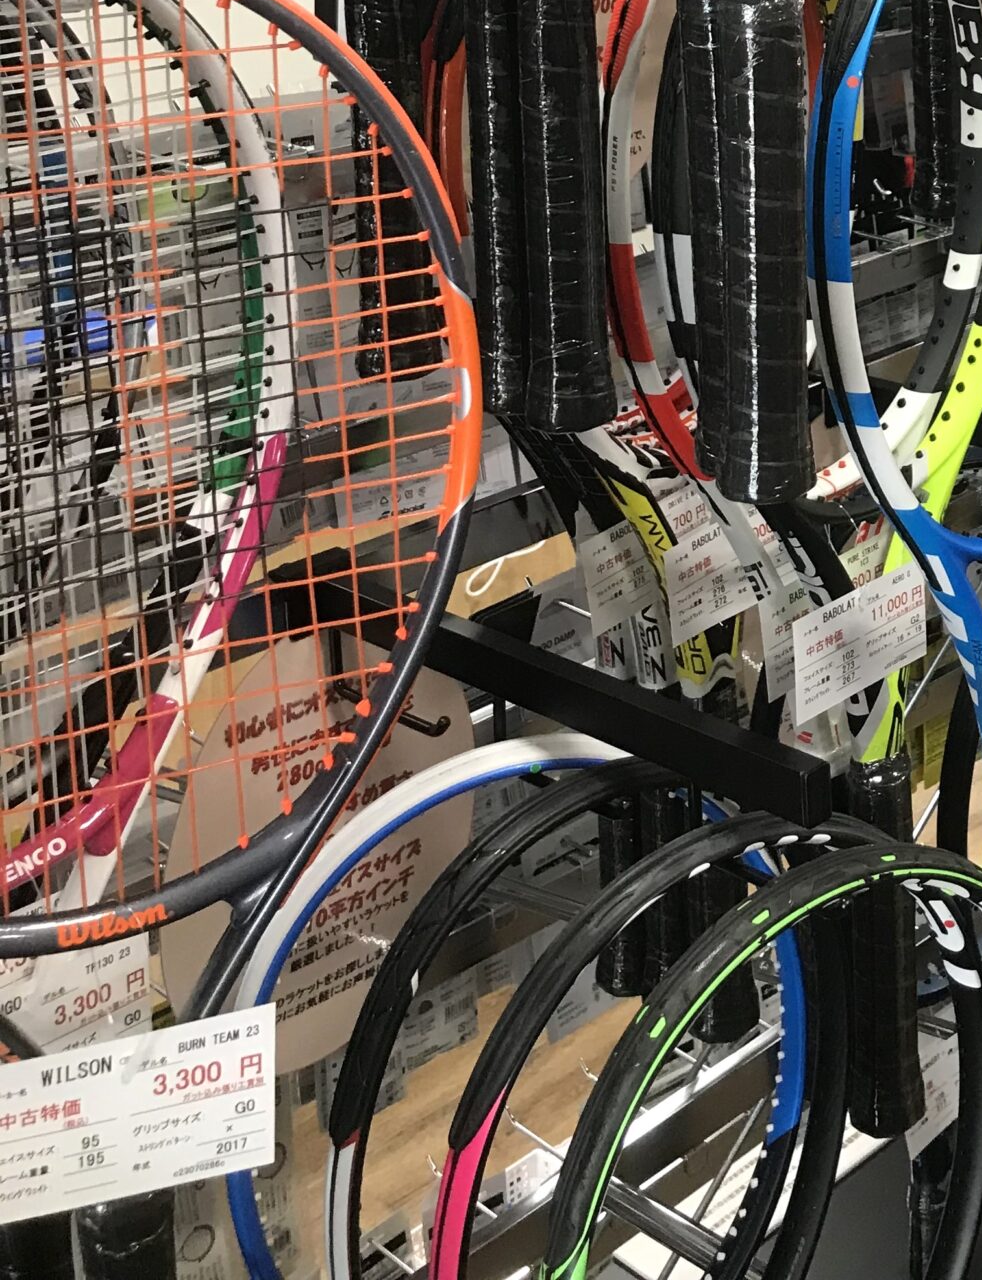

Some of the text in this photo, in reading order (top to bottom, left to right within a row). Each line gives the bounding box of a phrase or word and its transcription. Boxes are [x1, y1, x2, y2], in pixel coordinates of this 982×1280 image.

[696, 503, 705, 519] 円
[692, 527, 721, 551] BABOLAT
[597, 549, 632, 573] 中古特価
[679, 556, 711, 582] 中古特価
[892, 574, 904, 584] AERO
[806, 585, 921, 657] 中古特価 11,000 円
[823, 598, 856, 623] BABOLAT
[866, 614, 920, 647] グリップサイズ G2
[804, 650, 855, 681] フェイスサイズ 102
[804, 661, 855, 693] フレーム重量 273
[843, 673, 855, 685] 267
[119, 947, 131, 960] 23
[55, 968, 144, 1025] 3,300 円
[178, 1024, 259, 1053] BURN TEAM 23
[41, 1055, 113, 1087] WILSON
[0, 1053, 262, 1130] 中古特価 3,300 円
[133, 1112, 201, 1136] グリップサイズ
[82, 1135, 100, 1149] 95
[216, 1137, 247, 1155] 2017
[78, 1151, 105, 1168] 195
